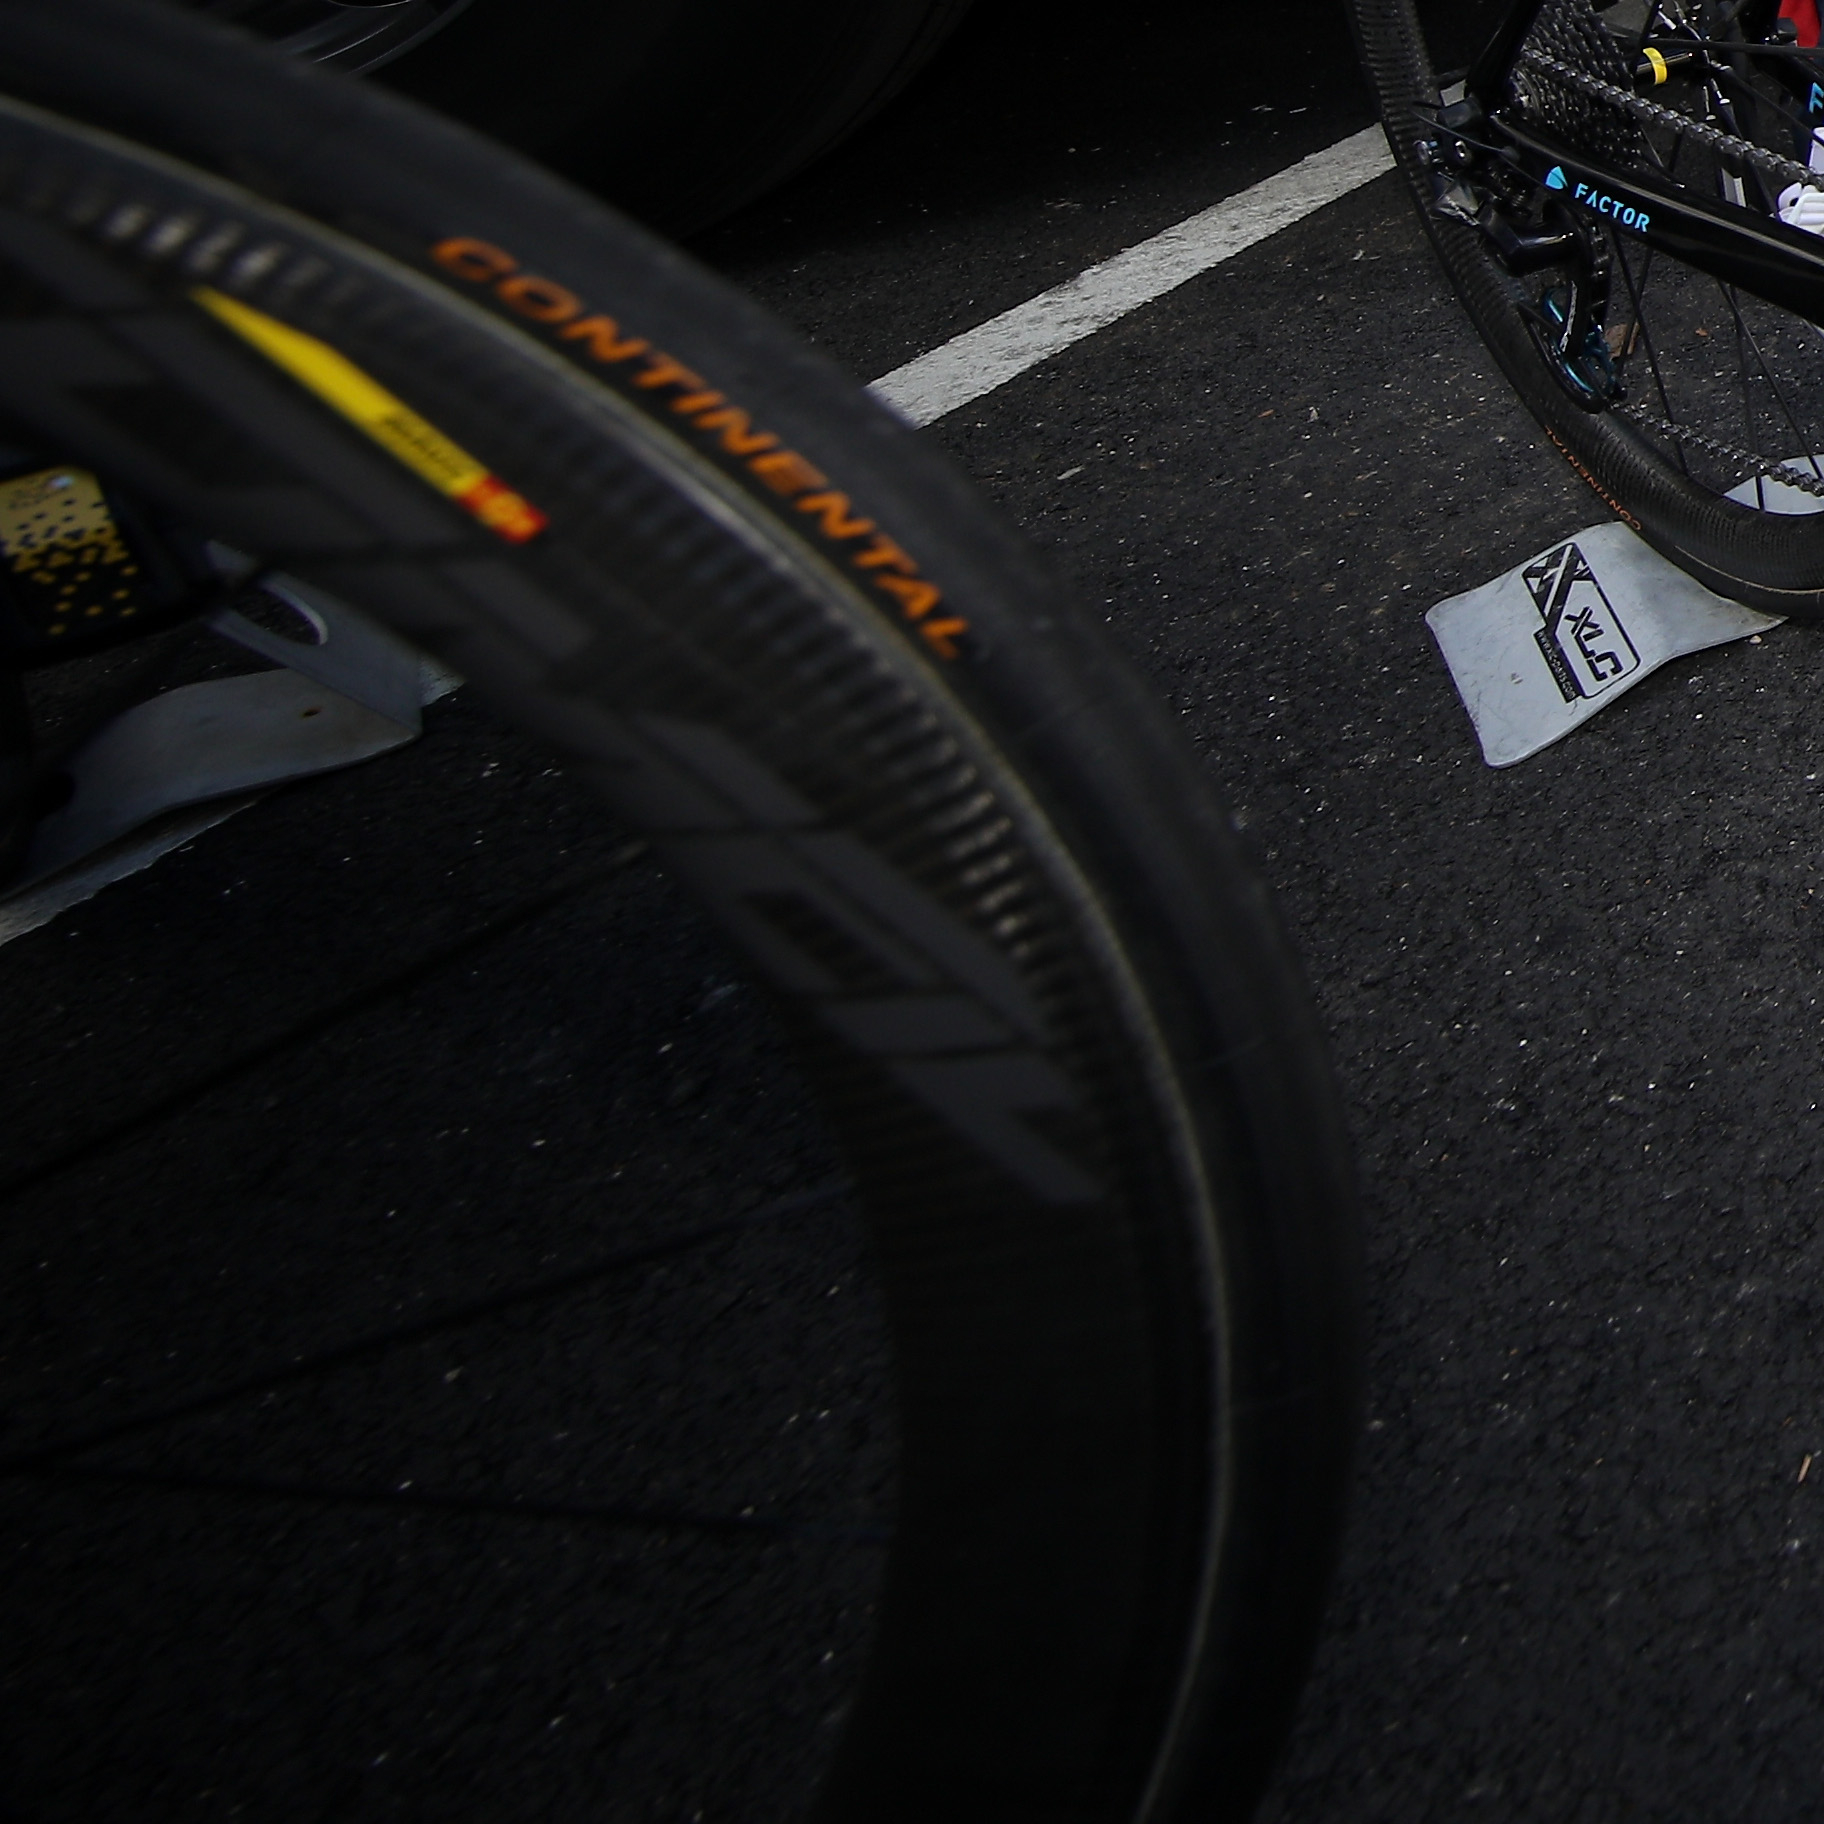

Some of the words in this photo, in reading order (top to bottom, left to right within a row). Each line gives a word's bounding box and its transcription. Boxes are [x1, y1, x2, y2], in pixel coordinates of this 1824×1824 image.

[1574, 182, 1650, 233] FACTOR
[430, 236, 972, 659] CONTINENTAL
[1564, 605, 1625, 682] XLC
